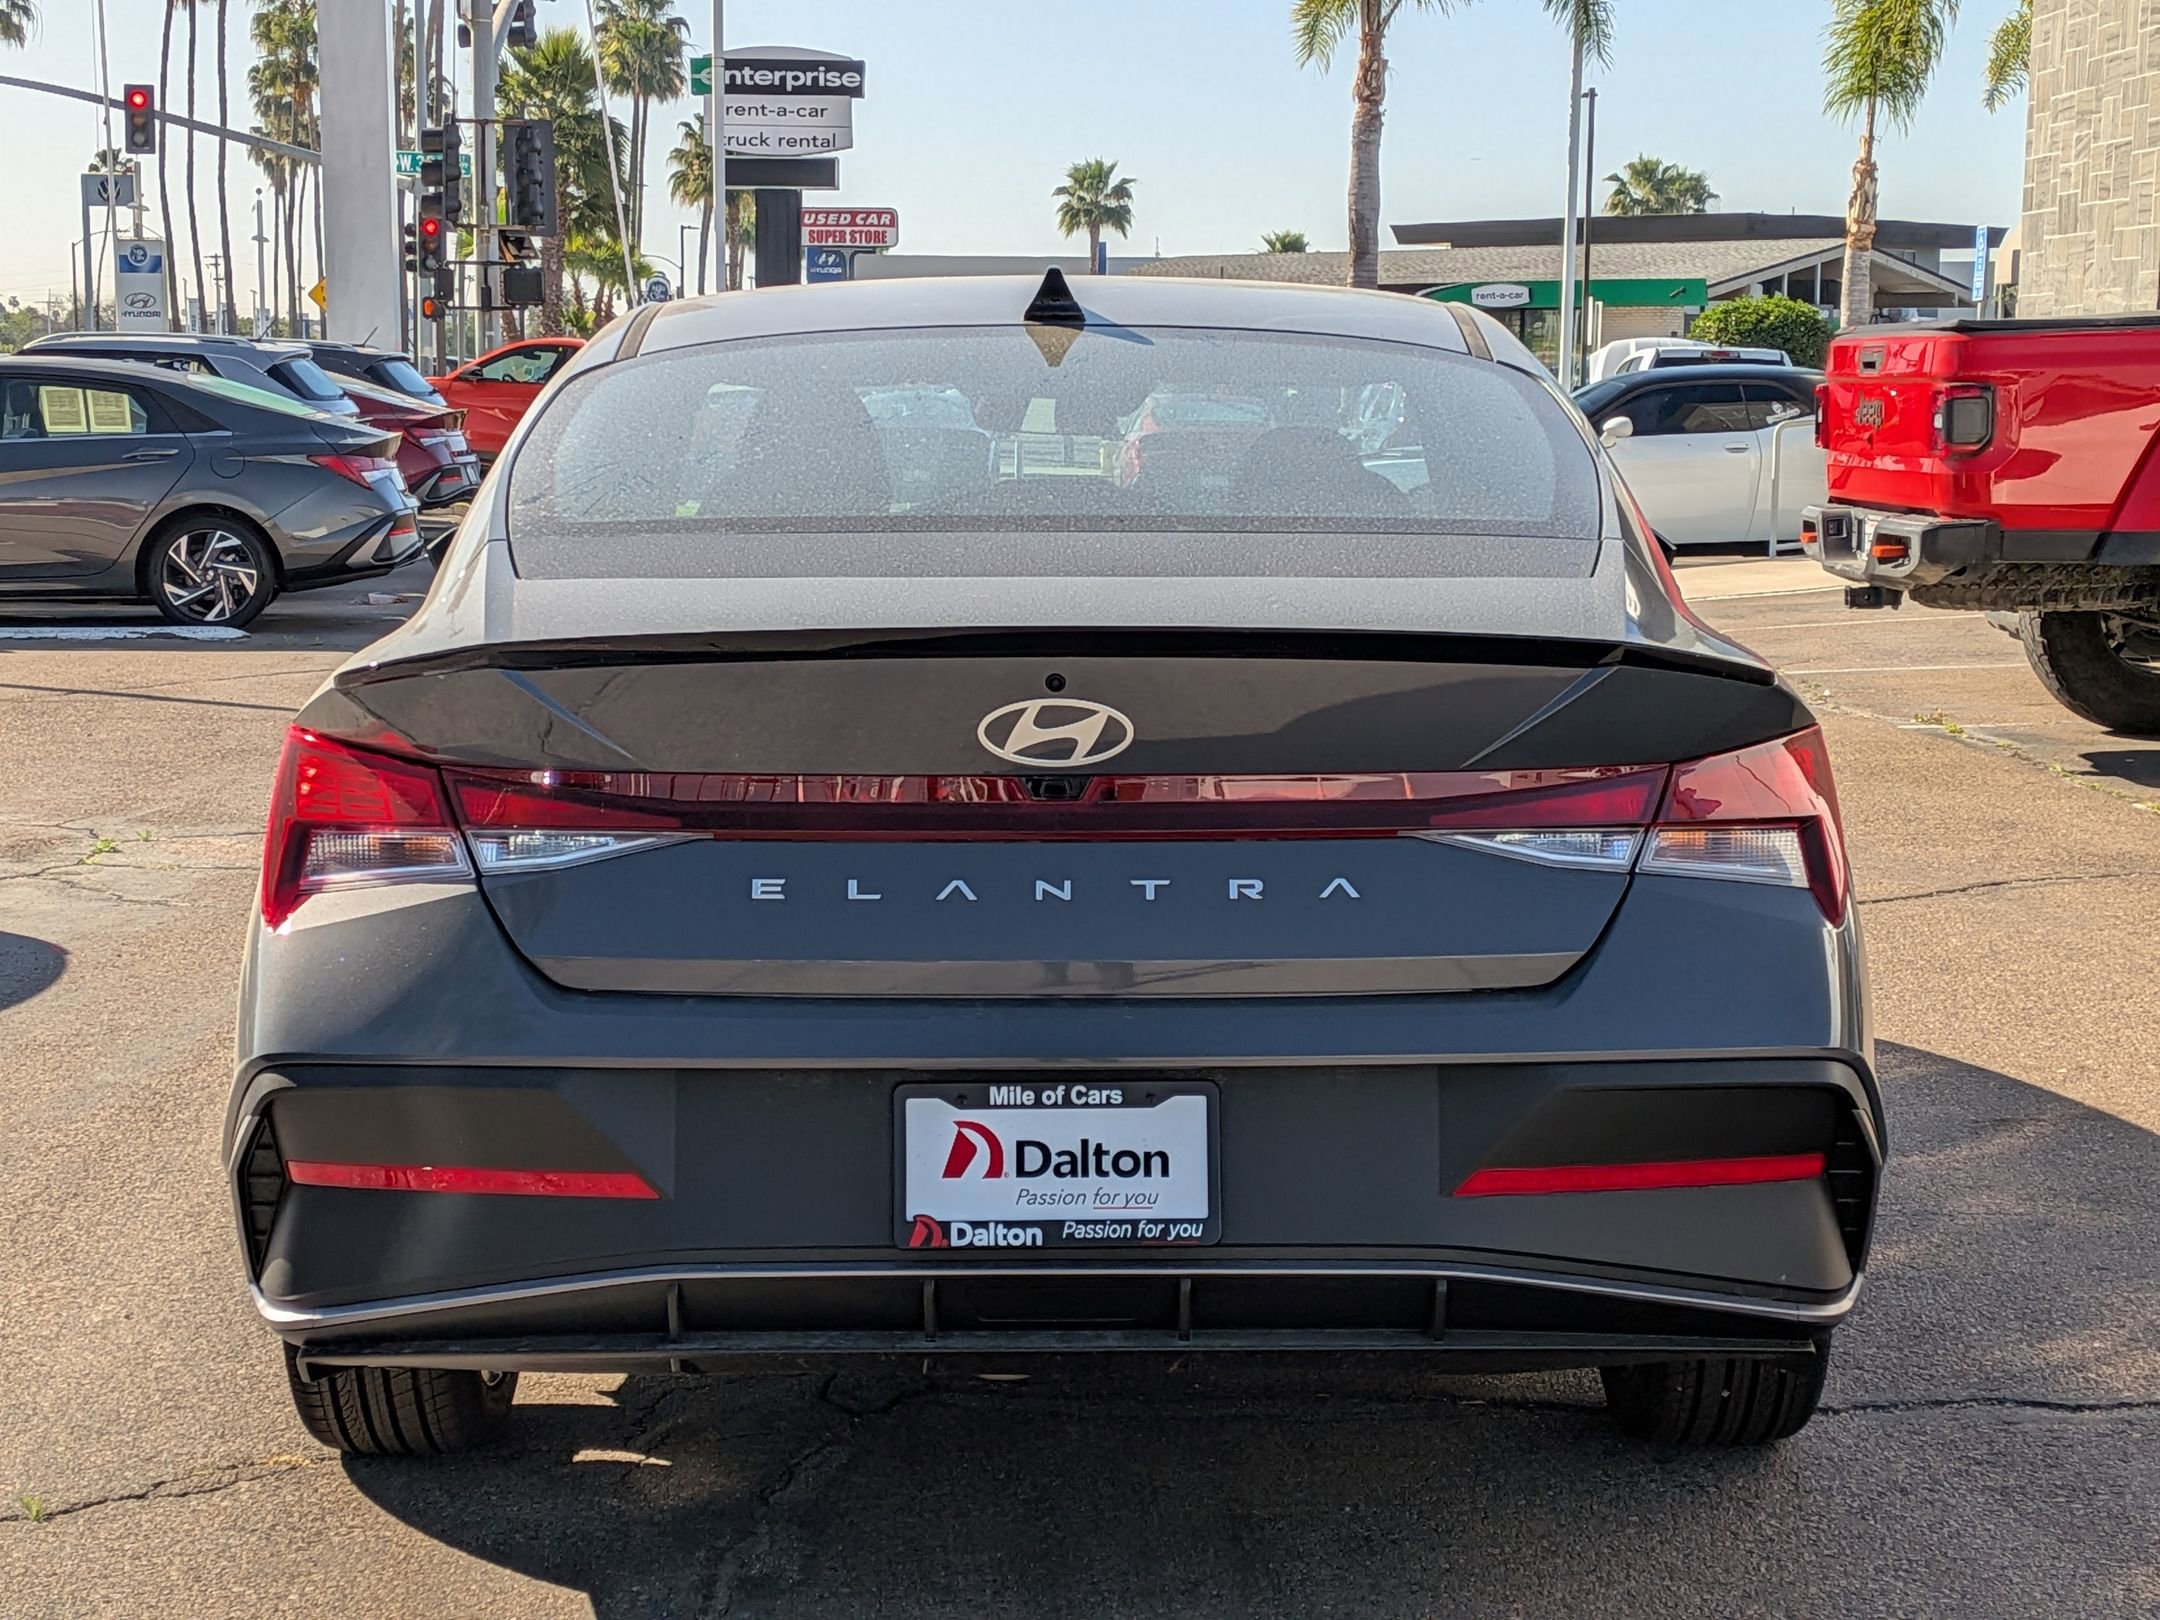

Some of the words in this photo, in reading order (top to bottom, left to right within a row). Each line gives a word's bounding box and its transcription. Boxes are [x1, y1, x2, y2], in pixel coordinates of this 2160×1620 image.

[726, 103, 828, 118] rent-a-car
[778, 133, 836, 148] rental
[803, 213, 853, 225] USED
[856, 213, 891, 225] CAR
[808, 229, 847, 244] SUPER
[849, 230, 888, 244] STORE
[1476, 292, 1524, 300] rent-a-car
[752, 878, 1362, 901] ELANTRA
[989, 1085, 1036, 1106] Mile
[1042, 1085, 1066, 1105] of
[1070, 1085, 1123, 1106] Cars
[1015, 1138, 1170, 1178] Dalton
[1015, 1188, 1086, 1206] Passion
[1091, 1187, 1120, 1208] for
[1122, 1191, 1159, 1208] you
[950, 1222, 1043, 1247] Dalton
[1062, 1221, 1134, 1239] Passion
[1136, 1220, 1166, 1241] for
[1168, 1222, 1203, 1242] you
